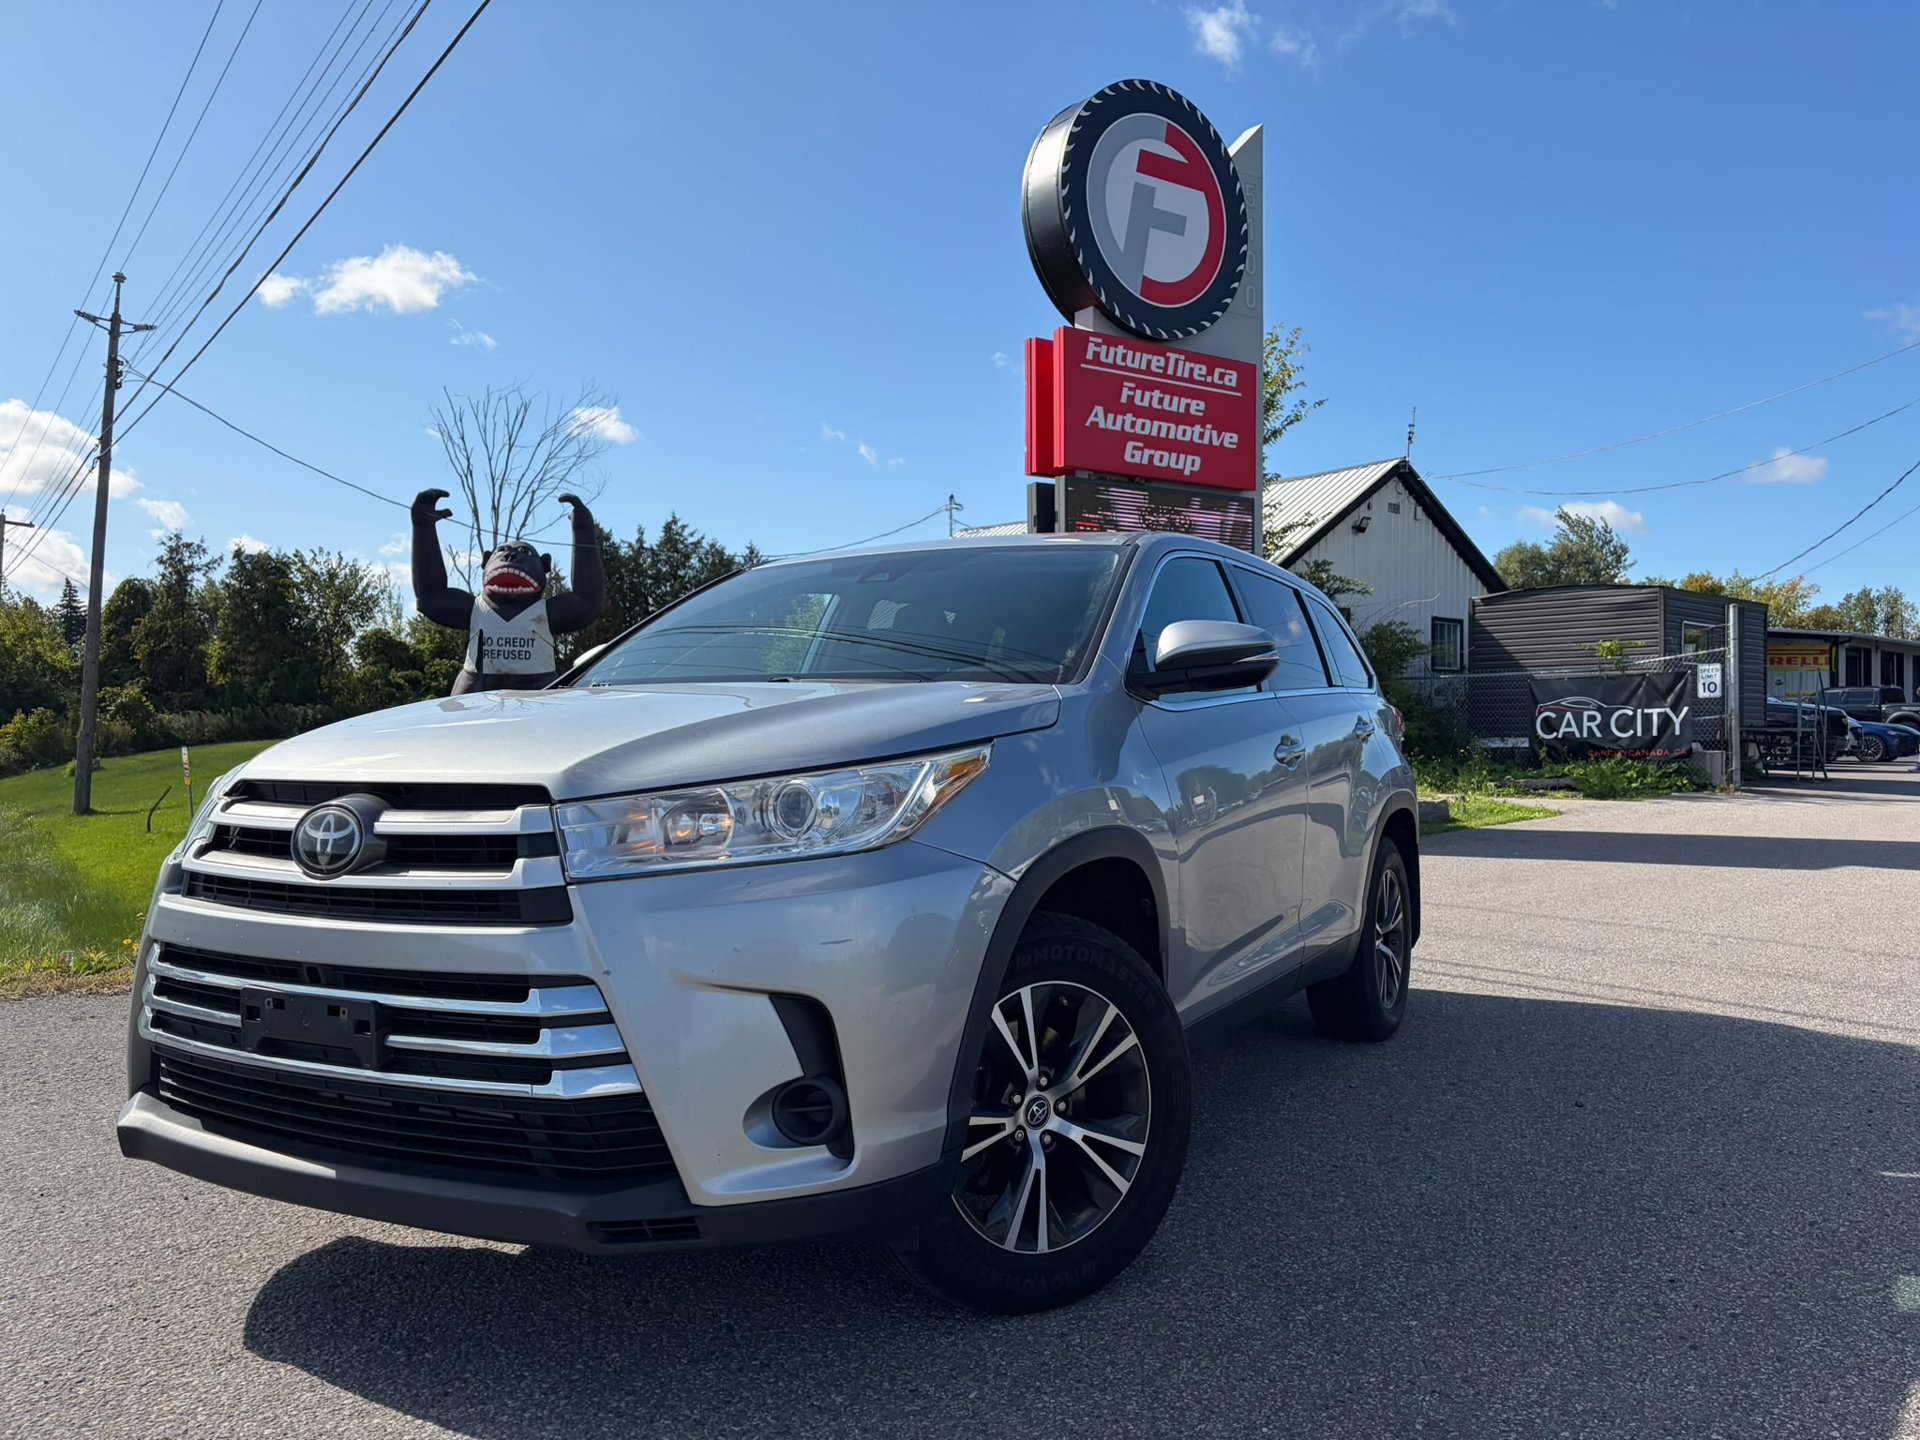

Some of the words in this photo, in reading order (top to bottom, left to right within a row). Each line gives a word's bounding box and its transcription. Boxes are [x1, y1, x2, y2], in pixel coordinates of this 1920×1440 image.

[1086, 336, 1238, 387] FutureTire.ca
[1120, 382, 1205, 416] Future
[1085, 405, 1238, 449] Automotive
[1124, 441, 1201, 476] Group
[483, 649, 531, 660] REFUSED
[497, 637, 536, 648] CREDIT
[1702, 681, 1717, 693] 10
[1536, 711, 1602, 739] CAR
[1610, 707, 1689, 738] CITY
